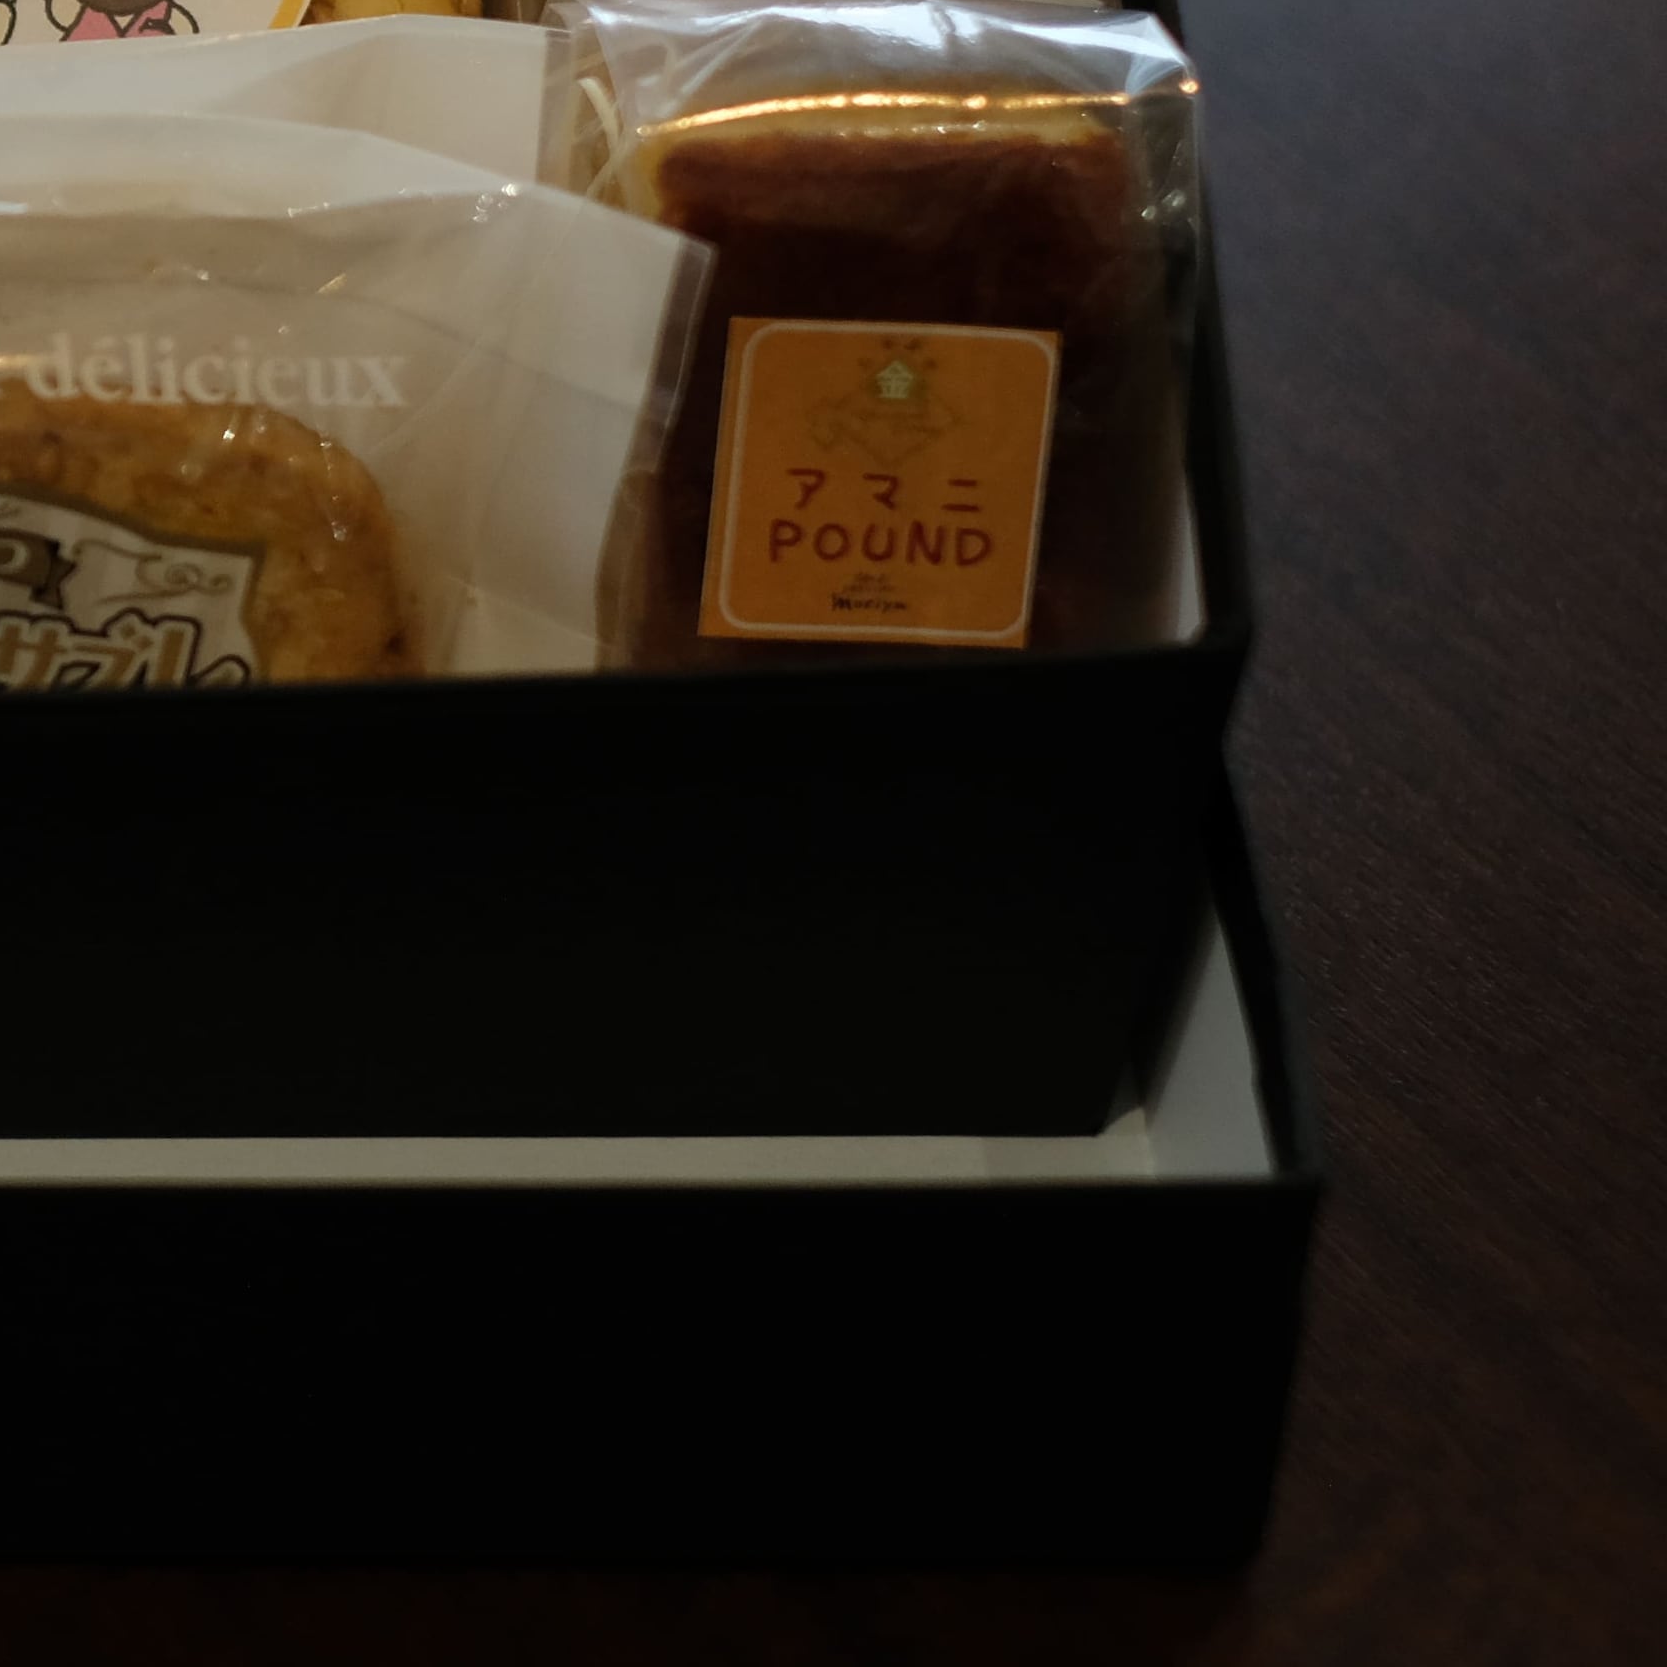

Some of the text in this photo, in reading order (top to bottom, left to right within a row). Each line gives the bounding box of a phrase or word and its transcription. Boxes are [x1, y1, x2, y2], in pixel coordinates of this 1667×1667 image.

[26, 333, 409, 408] délicieux
[786, 467, 982, 513] アマニ
[768, 518, 995, 567] POUND
